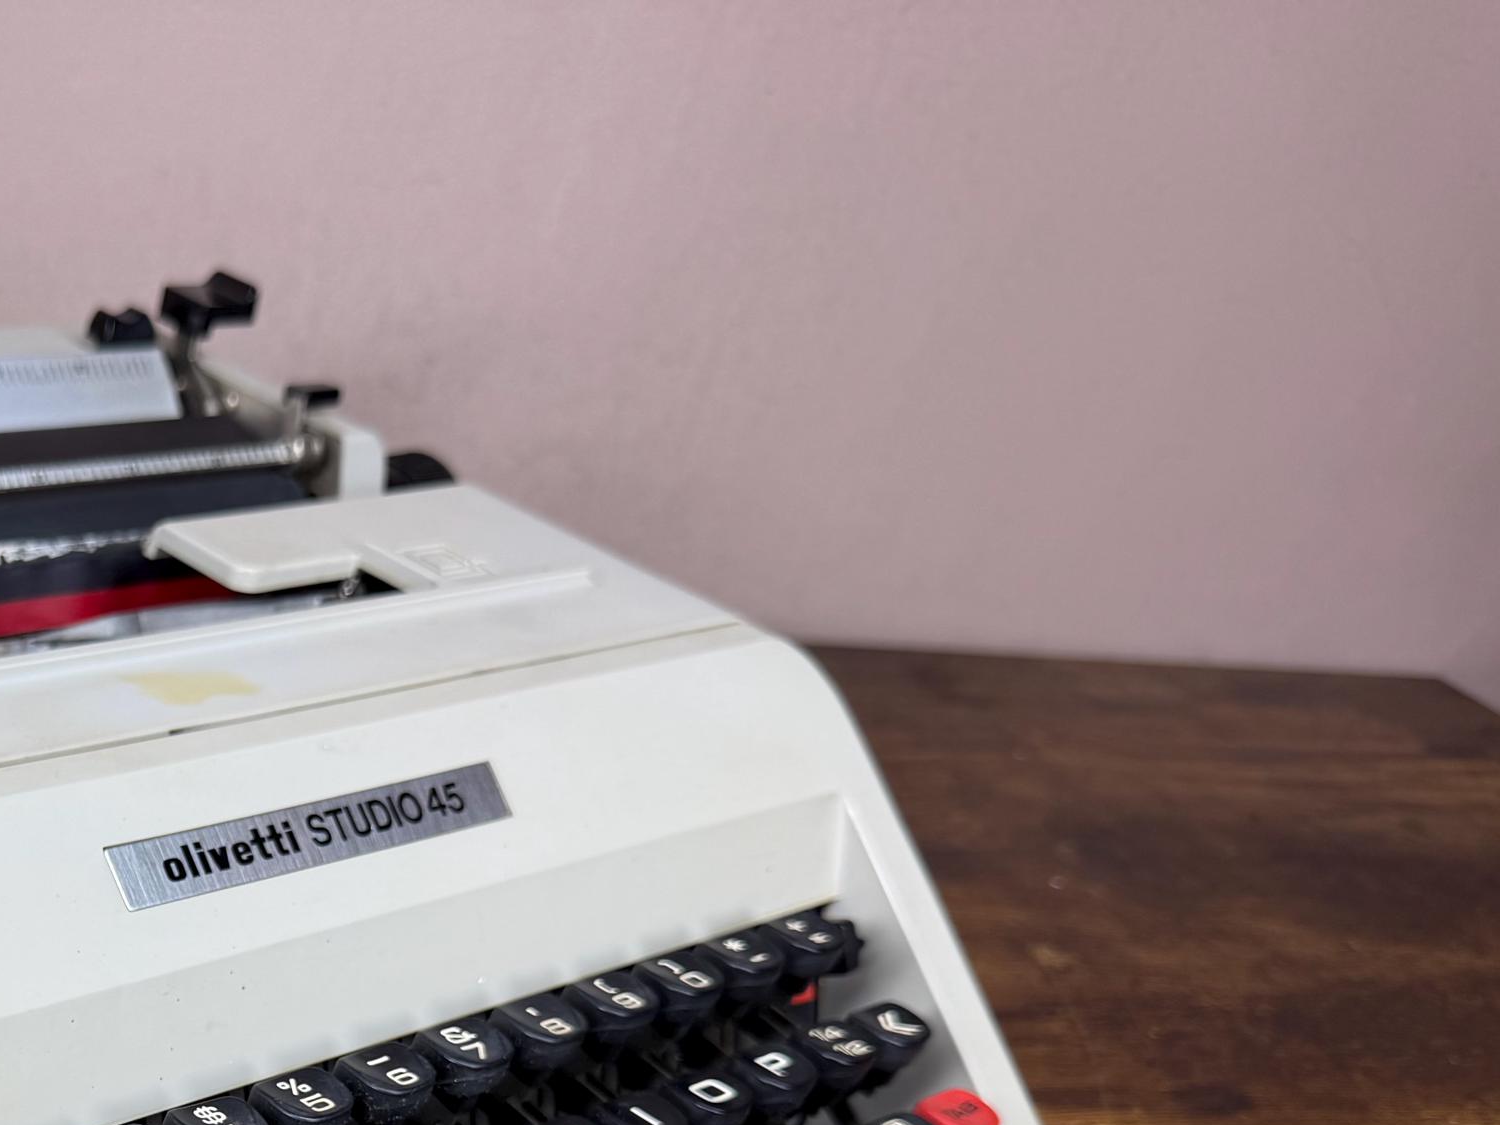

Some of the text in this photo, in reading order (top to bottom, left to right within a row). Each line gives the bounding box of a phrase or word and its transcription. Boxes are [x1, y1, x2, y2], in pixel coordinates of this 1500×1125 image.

[163, 783, 466, 882] olivetti STUDIO 45
[611, 991, 645, 1010] 9
[539, 1017, 574, 1035] 8
[439, 1026, 479, 1048] &
[457, 1038, 487, 1060] 7
[754, 1052, 791, 1077] P
[385, 1067, 420, 1086] 6
[276, 1078, 313, 1096] %
[688, 1078, 736, 1104] O
[299, 1092, 336, 1112] 5
[192, 1105, 228, 1125] $
